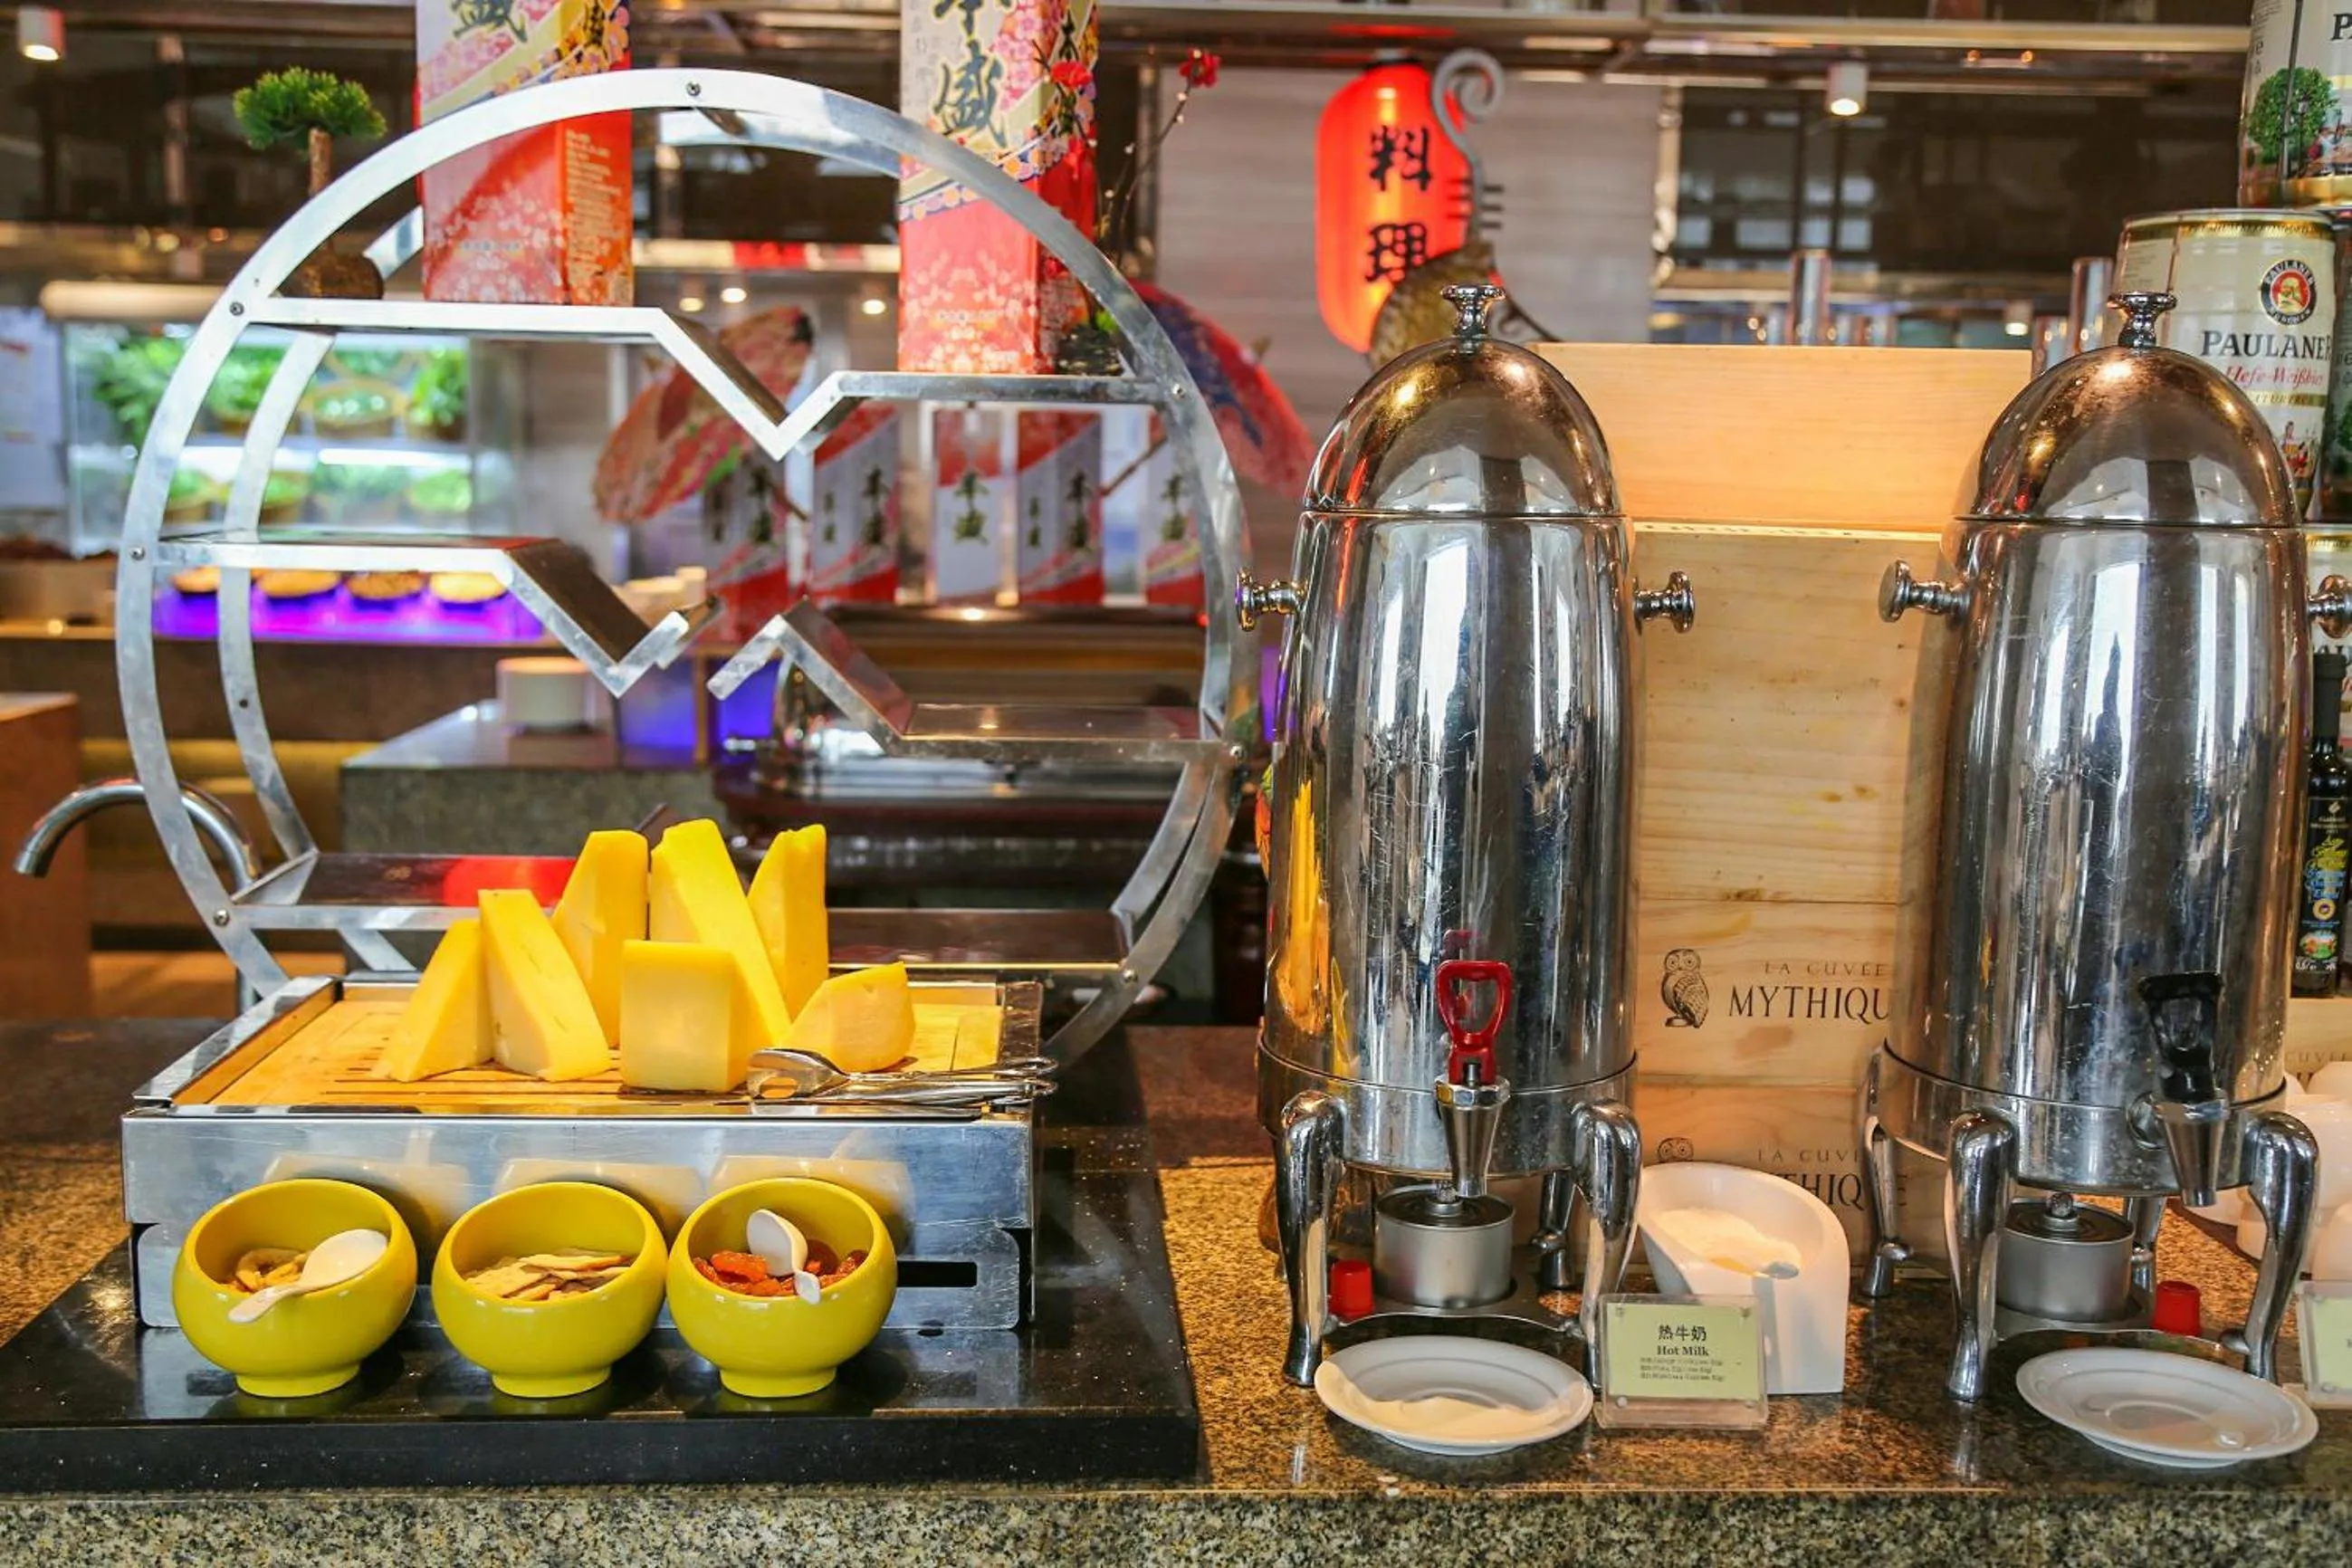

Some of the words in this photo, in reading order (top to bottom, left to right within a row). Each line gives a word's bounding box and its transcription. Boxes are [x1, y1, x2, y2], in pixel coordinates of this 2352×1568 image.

[1364, 124, 1432, 283] 料理
[1764, 962, 1790, 975] LA
[1729, 985, 1890, 1025] MYTHIQU
[1799, 1149, 1859, 1162] CUV
[1657, 1345, 1679, 1356] Hot
[1682, 1345, 1709, 1356] Milk
